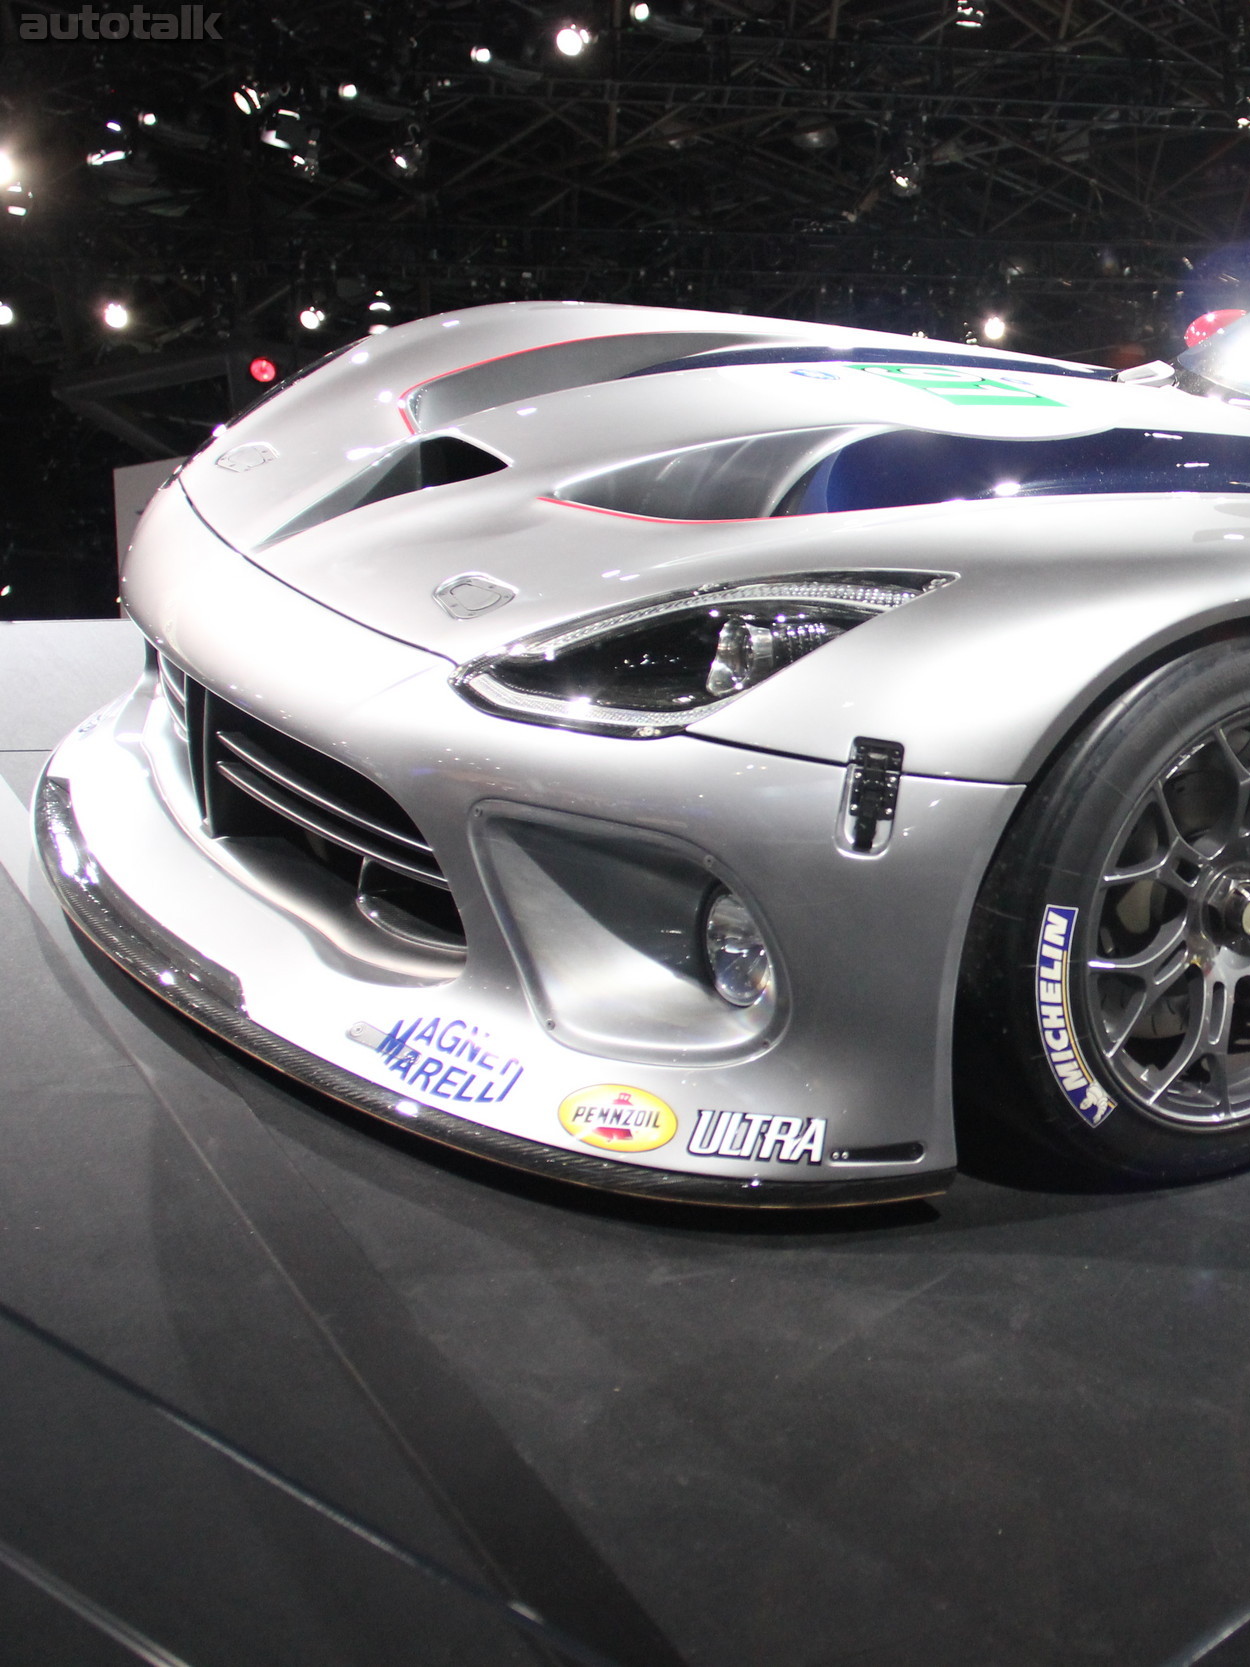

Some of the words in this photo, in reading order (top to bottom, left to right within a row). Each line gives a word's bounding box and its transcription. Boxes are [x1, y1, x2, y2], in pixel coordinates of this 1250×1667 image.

[1040, 911, 1088, 1092] MICHELIN
[572, 1105, 661, 1129] PENNZOIL
[687, 1109, 829, 1166] ULTRA
